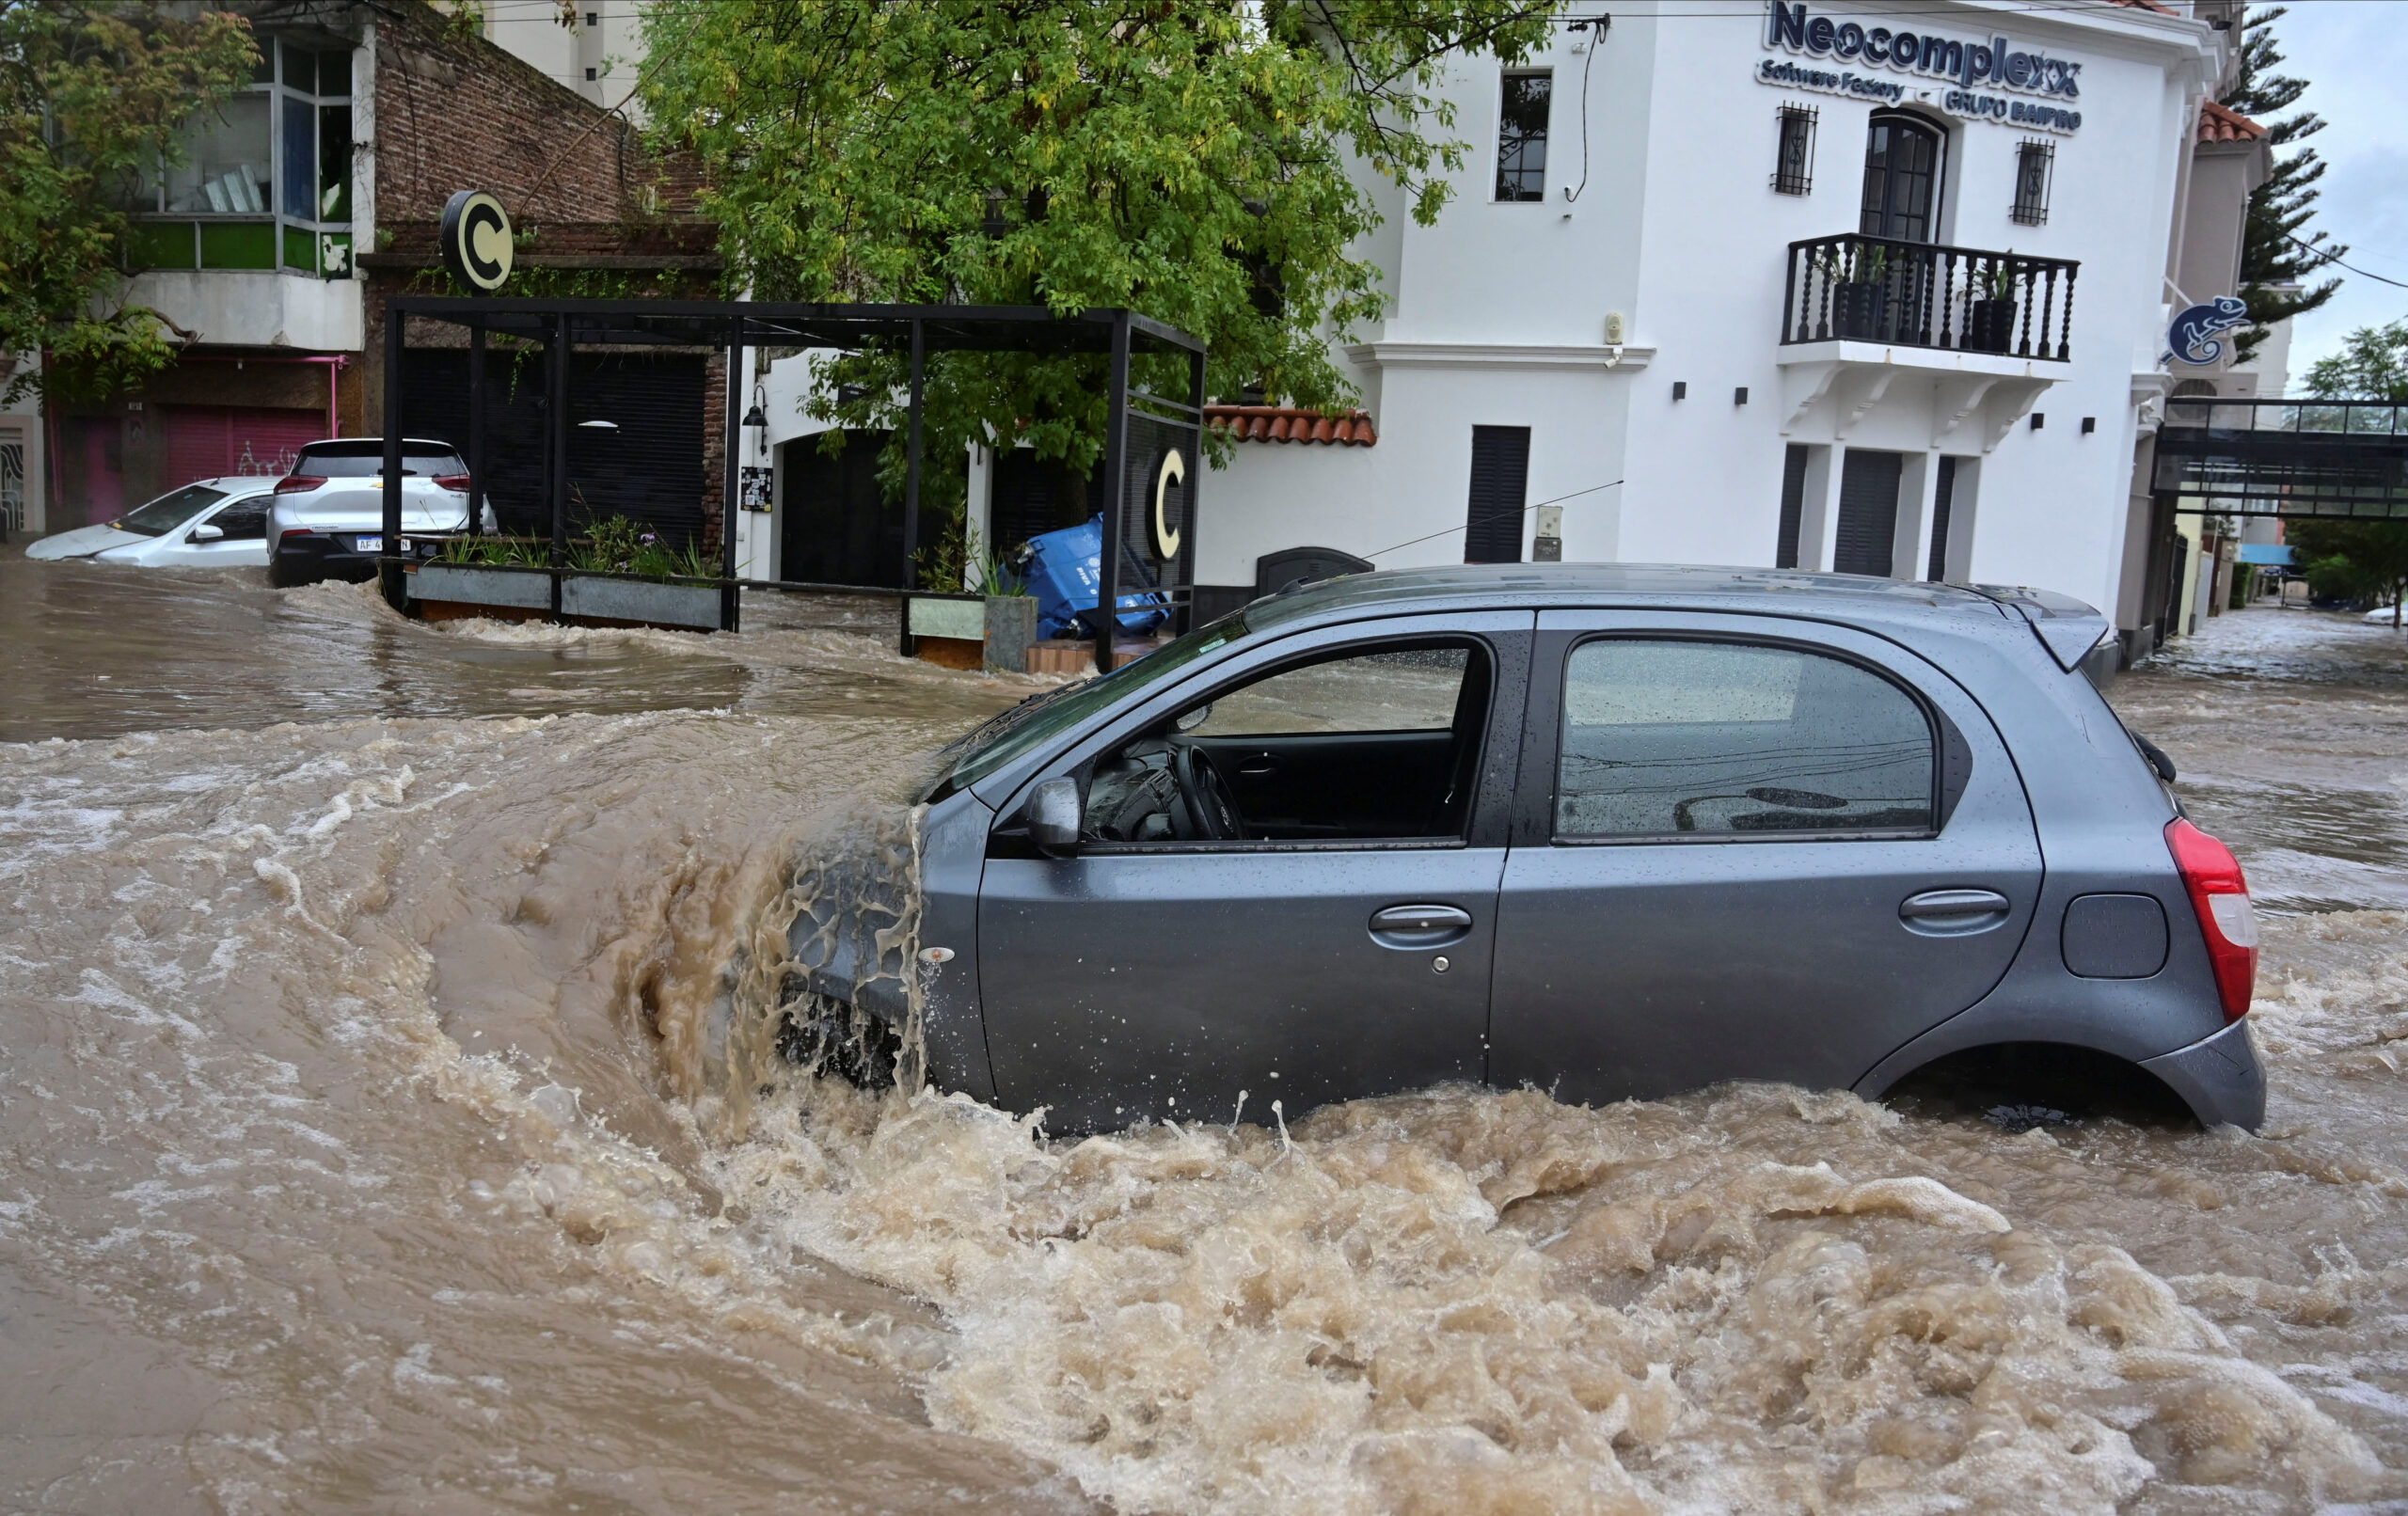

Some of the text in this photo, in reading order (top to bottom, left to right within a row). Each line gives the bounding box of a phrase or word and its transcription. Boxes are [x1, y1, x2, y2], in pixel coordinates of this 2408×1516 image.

[1768, 1, 2082, 96] Neocomplexx
[1761, 59, 1905, 103] Software Factory
[1945, 90, 2007, 118] GRUPO
[464, 202, 504, 281] C
[1155, 449, 1185, 560] C
[359, 540, 372, 549] AF
